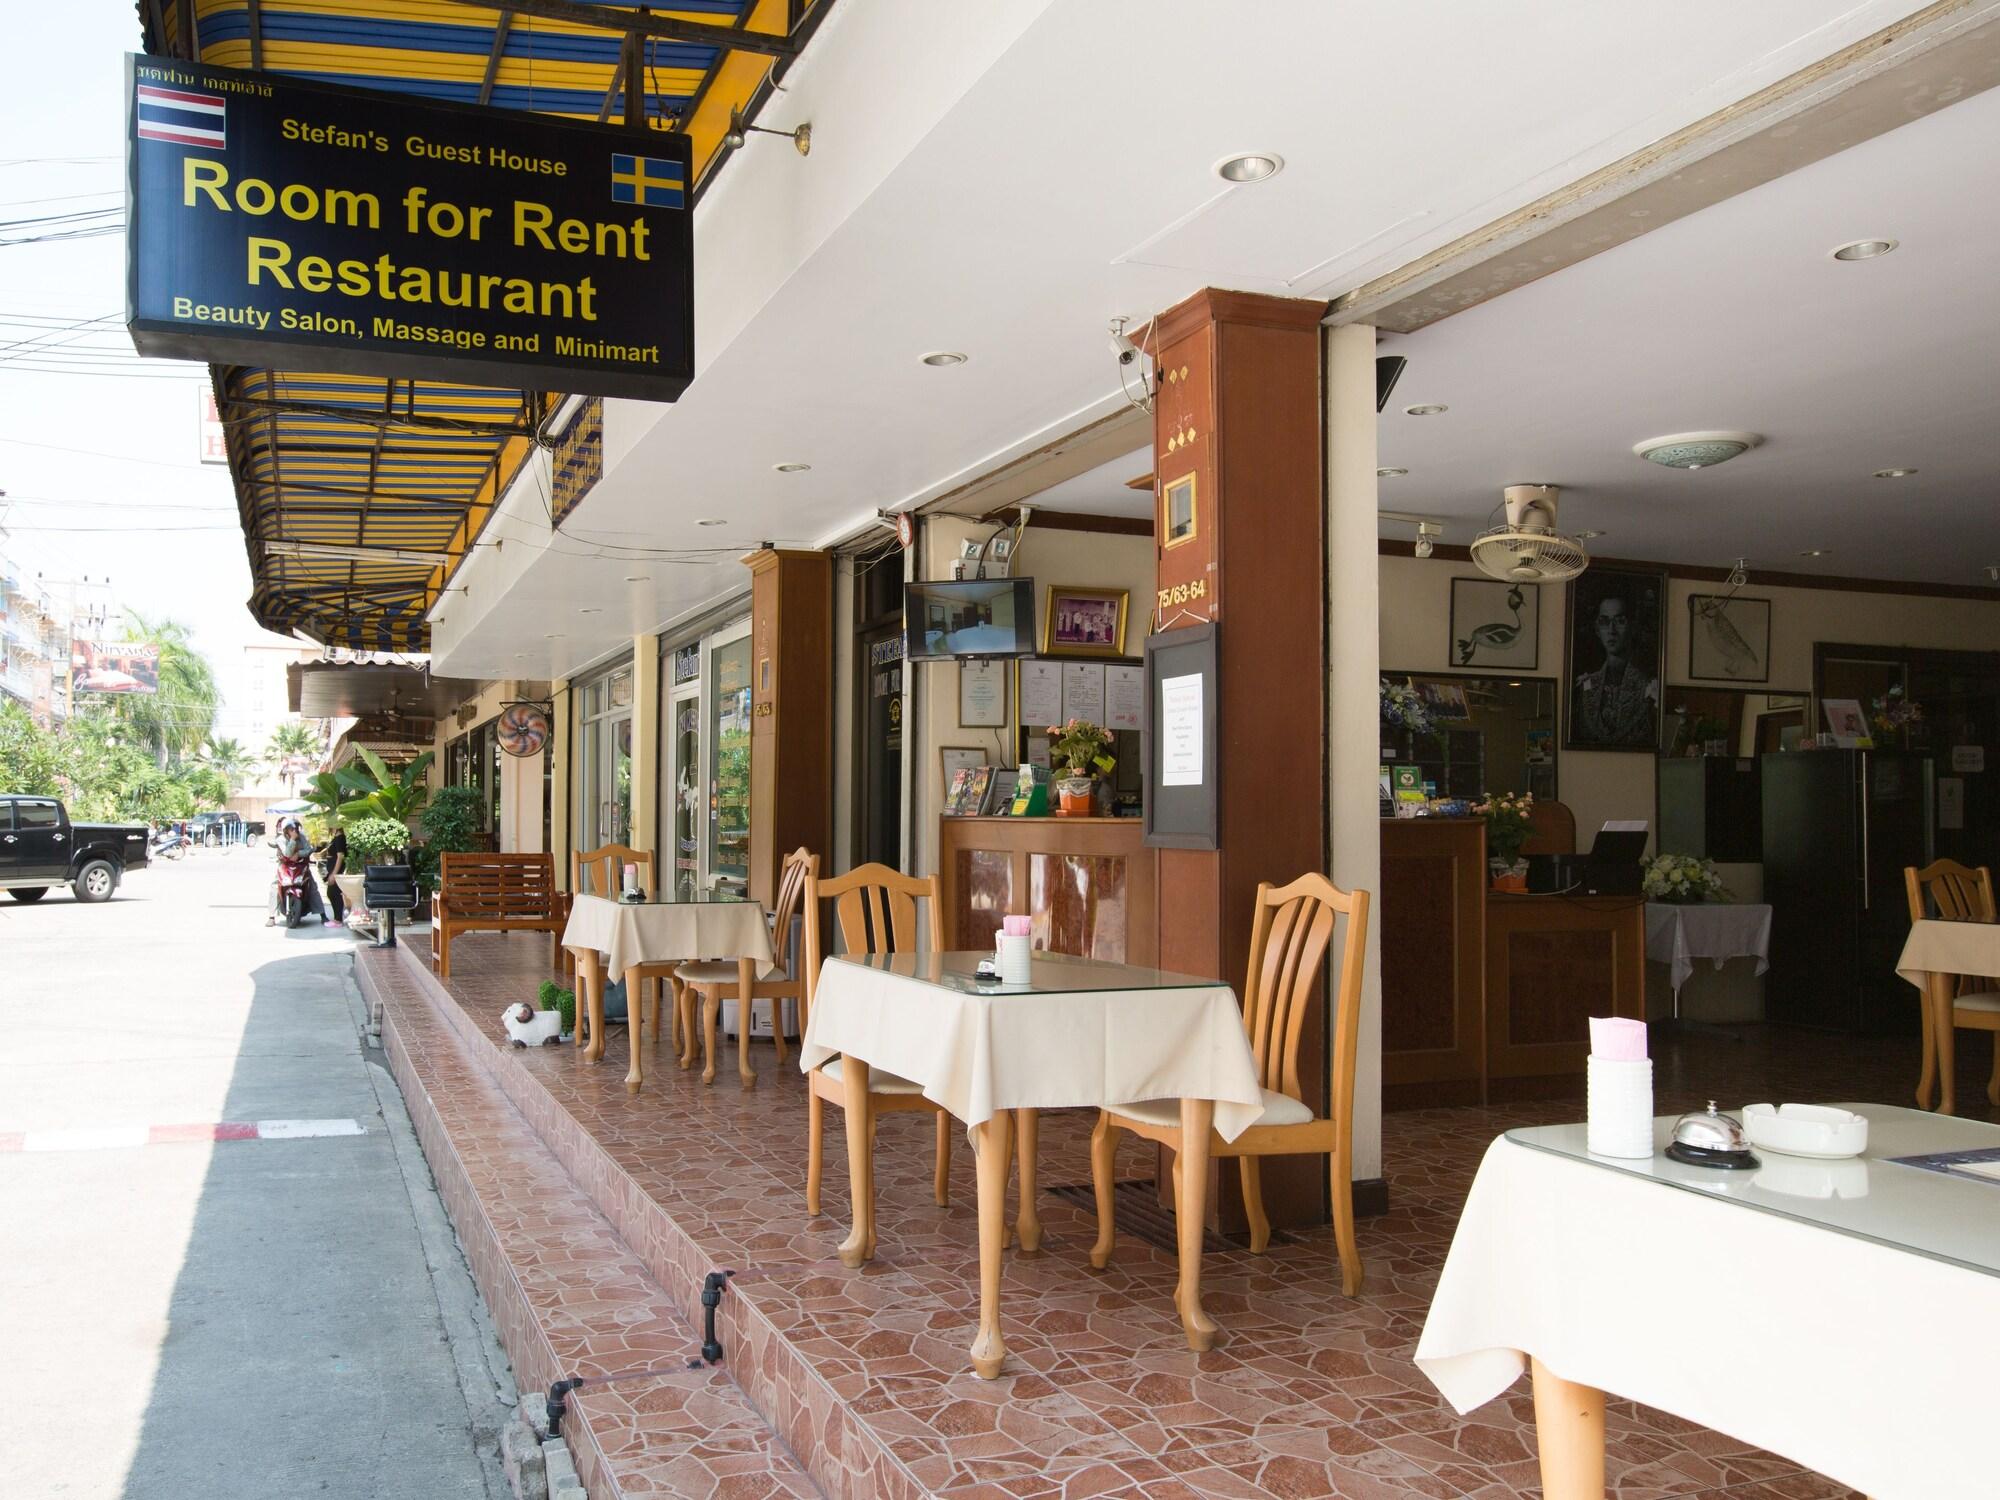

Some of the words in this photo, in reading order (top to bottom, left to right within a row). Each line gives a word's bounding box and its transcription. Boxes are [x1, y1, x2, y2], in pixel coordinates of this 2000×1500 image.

[282, 119, 389, 151] Stefan's
[406, 136, 482, 165] Guest
[489, 147, 568, 176] House
[184, 157, 380, 229] Room
[403, 187, 492, 240] for
[515, 201, 650, 260] Rent
[247, 236, 598, 321] Restaurant
[174, 297, 271, 330] Beauty
[280, 308, 363, 339] Salon,
[374, 318, 485, 349] Massage
[495, 334, 538, 352] and
[556, 336, 658, 363] Minimart
[1158, 579, 1205, 608] 75/63-64
